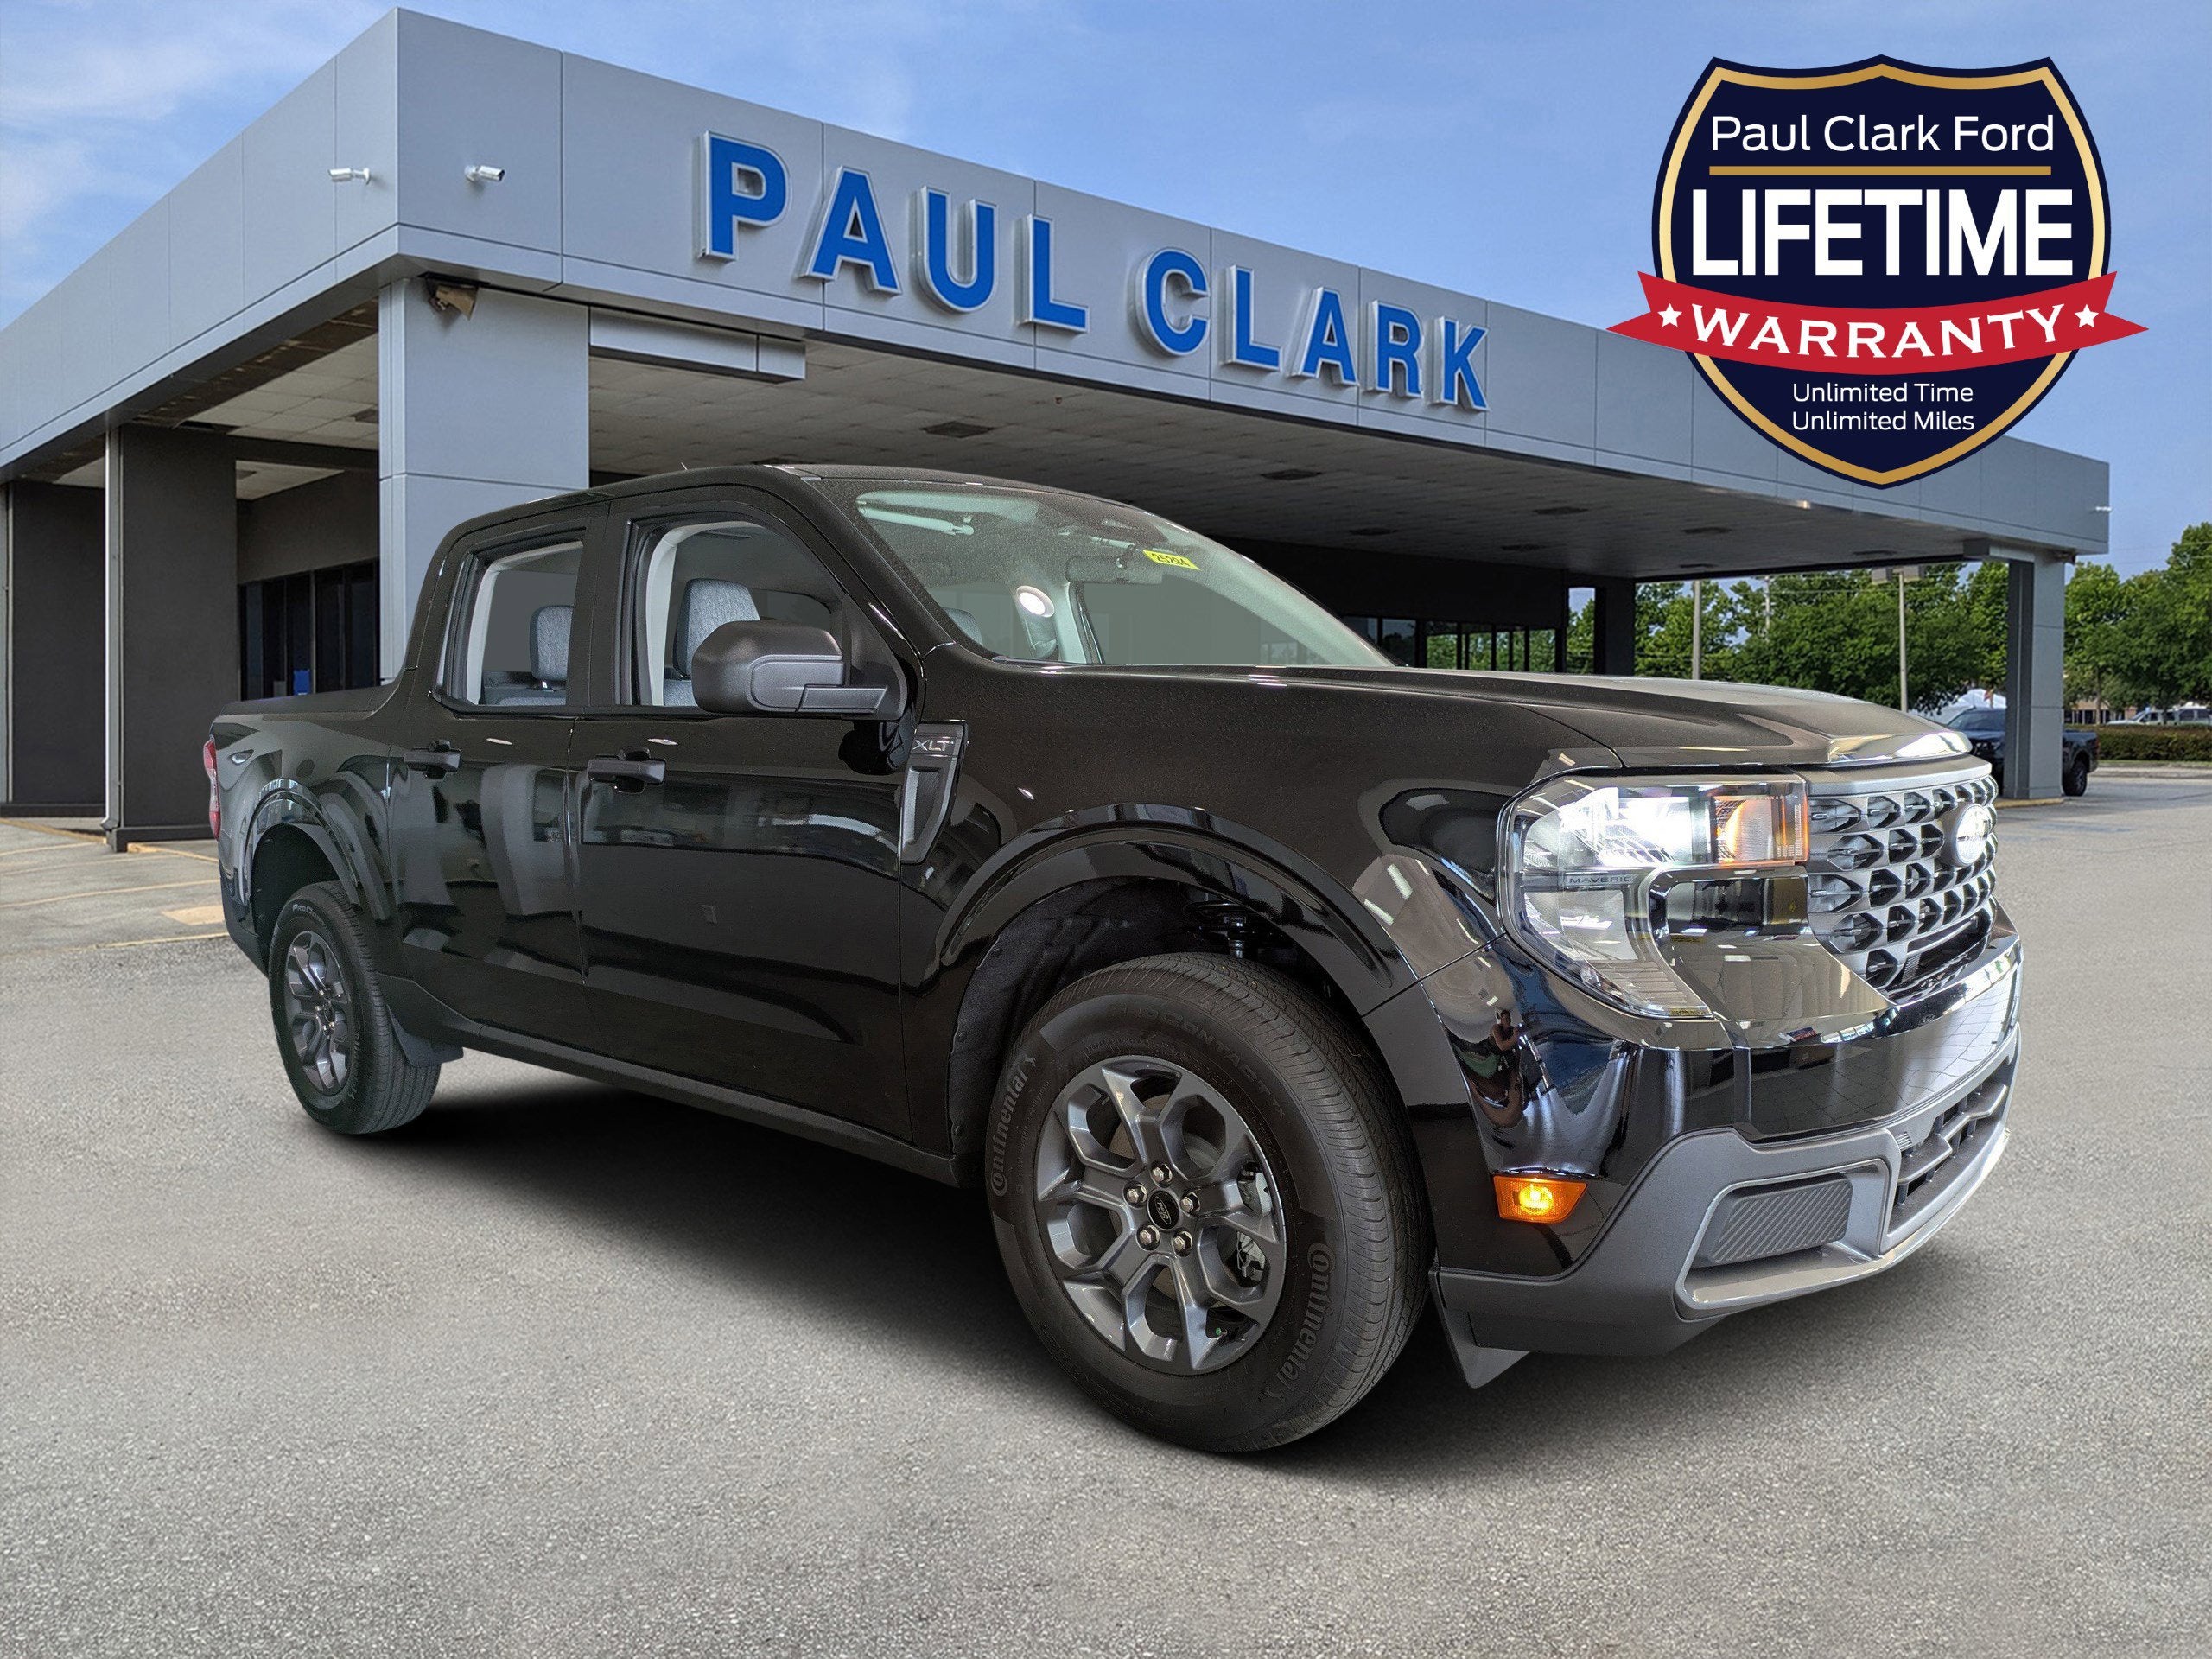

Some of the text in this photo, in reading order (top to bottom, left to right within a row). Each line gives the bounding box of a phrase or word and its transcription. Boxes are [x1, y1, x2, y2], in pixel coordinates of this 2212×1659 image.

[702, 131, 1488, 410] PAUL CLARK
[912, 739, 954, 752] XLT
[991, 1064, 1028, 1197] Continental
[1275, 1242, 1336, 1392] Continental
